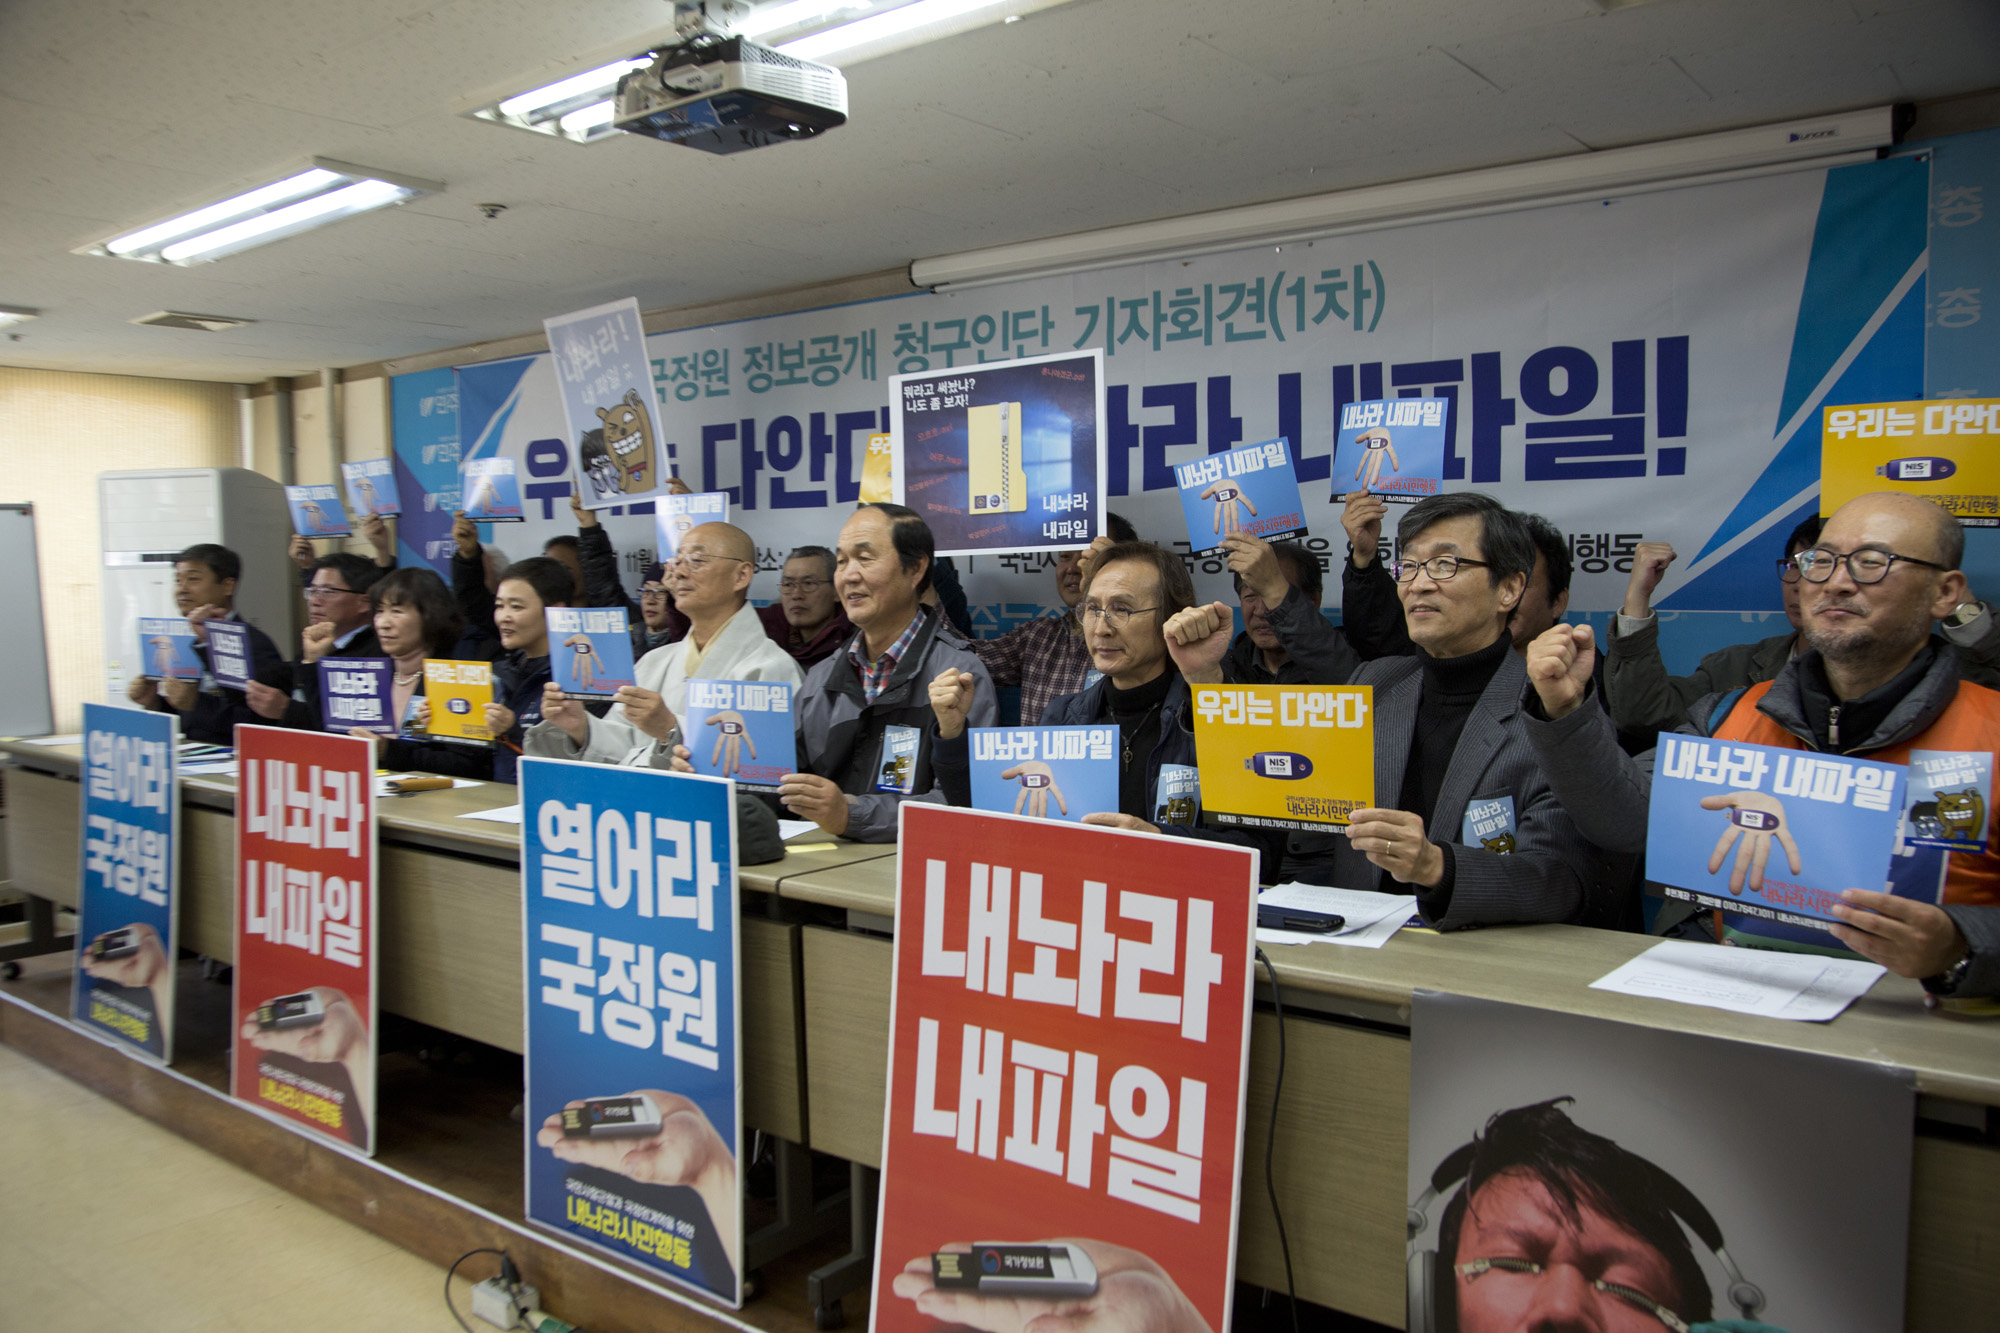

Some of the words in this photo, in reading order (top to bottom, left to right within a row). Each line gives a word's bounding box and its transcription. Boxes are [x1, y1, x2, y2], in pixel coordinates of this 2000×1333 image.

[650, 348, 730, 403] 국정원
[741, 328, 877, 394] 정보공개
[892, 305, 1055, 375] 청구인단
[1073, 260, 1386, 356] 기자회견(1차)
[904, 383, 935, 399] 뭐라고
[906, 399, 928, 413] 나도
[930, 397, 941, 411] 좀
[944, 394, 969, 408] 보자!
[1343, 403, 1385, 430] 내놔라
[1385, 402, 1442, 427] 내파일
[1827, 408, 1916, 439] 우리는
[1177, 457, 1223, 490] 내놔라
[1225, 441, 1287, 477] 내파일
[1043, 493, 1089, 513] 내놔라
[1376, 481, 1438, 494] 내놔라시민행동
[1043, 519, 1089, 540] 내파일
[736, 684, 789, 712] 내파일
[1197, 690, 1273, 726] 우리는
[1280, 692, 1368, 729] 다안다
[974, 731, 1038, 761] 내놔라
[1043, 730, 1113, 760] 내파일
[87, 730, 170, 815] 열어라
[1269, 758, 1286, 767] NIS
[1663, 739, 1769, 790] 내놔라
[1773, 754, 1896, 812] 내파일
[1914, 754, 1981, 774] “내놔라,
[1927, 767, 1986, 789] 내파일”
[245, 758, 364, 858] 내놔라
[1287, 802, 1360, 820] 내놔라시민행
[1473, 811, 1511, 837] 내파일”
[86, 814, 169, 907] 국정원
[537, 798, 720, 932] 열어라
[245, 859, 363, 968] 내파일
[921, 858, 1223, 1043] 내놔라
[540, 922, 719, 1071] 국정원
[913, 1016, 1208, 1224] 내파일
[567, 1195, 693, 1270] 내놔라시민행동
